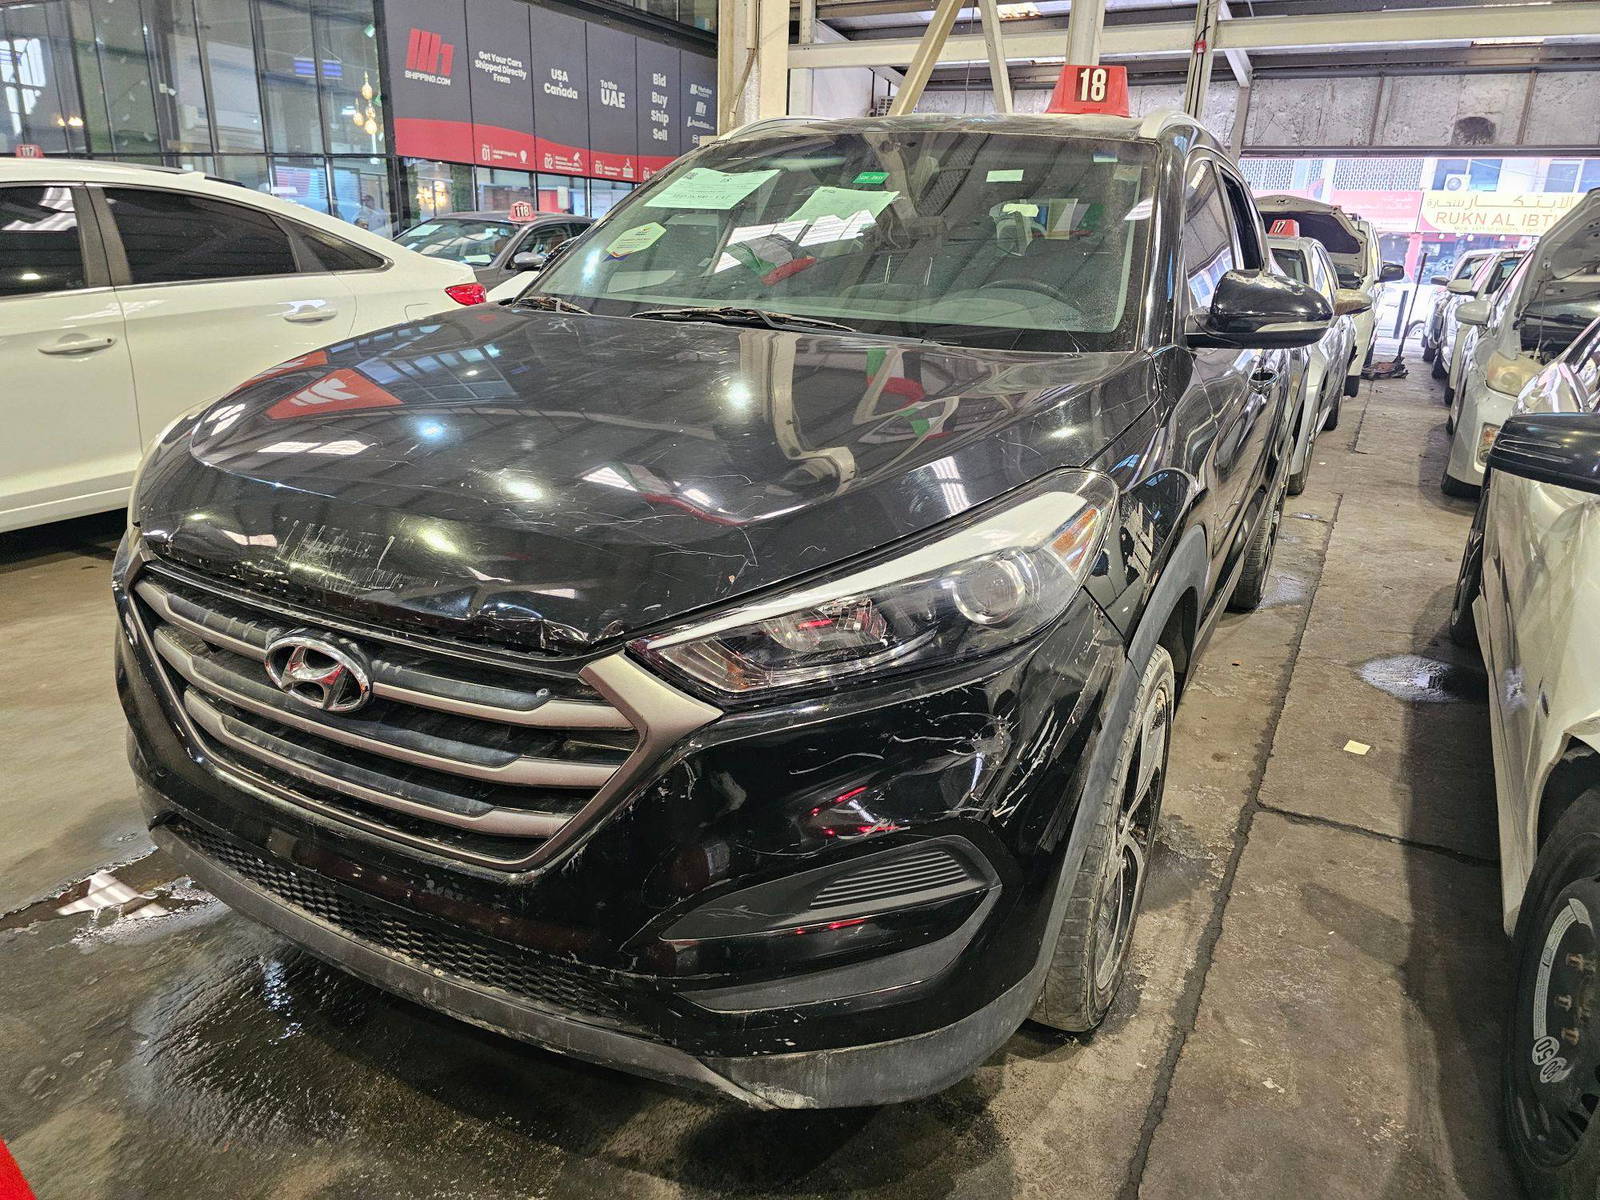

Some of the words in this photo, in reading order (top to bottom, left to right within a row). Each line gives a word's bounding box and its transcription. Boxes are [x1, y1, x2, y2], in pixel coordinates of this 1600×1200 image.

[478, 51, 491, 61] Get
[491, 53, 506, 63] Your
[507, 57, 522, 68] Cars
[474, 59, 502, 73] Shipped
[502, 65, 527, 80] Directly
[551, 68, 569, 82] USA
[404, 70, 451, 86] SHIPPING.COM
[493, 73, 511, 84] From
[600, 79, 607, 88] To
[608, 81, 618, 90] the
[653, 72, 666, 87] Bid
[1080, 68, 1107, 102] 18
[544, 83, 578, 99] Canada
[601, 88, 626, 109] UAE
[652, 91, 668, 109] Buy
[651, 110, 669, 126] Ship
[652, 128, 668, 141] Sell
[481, 147, 491, 161] 01
[544, 156, 554, 170] 02
[515, 205, 530, 218] 118
[1274, 220, 1287, 233] 17
[1435, 211, 1488, 226] RUKN
[1491, 212, 1515, 228] AL
